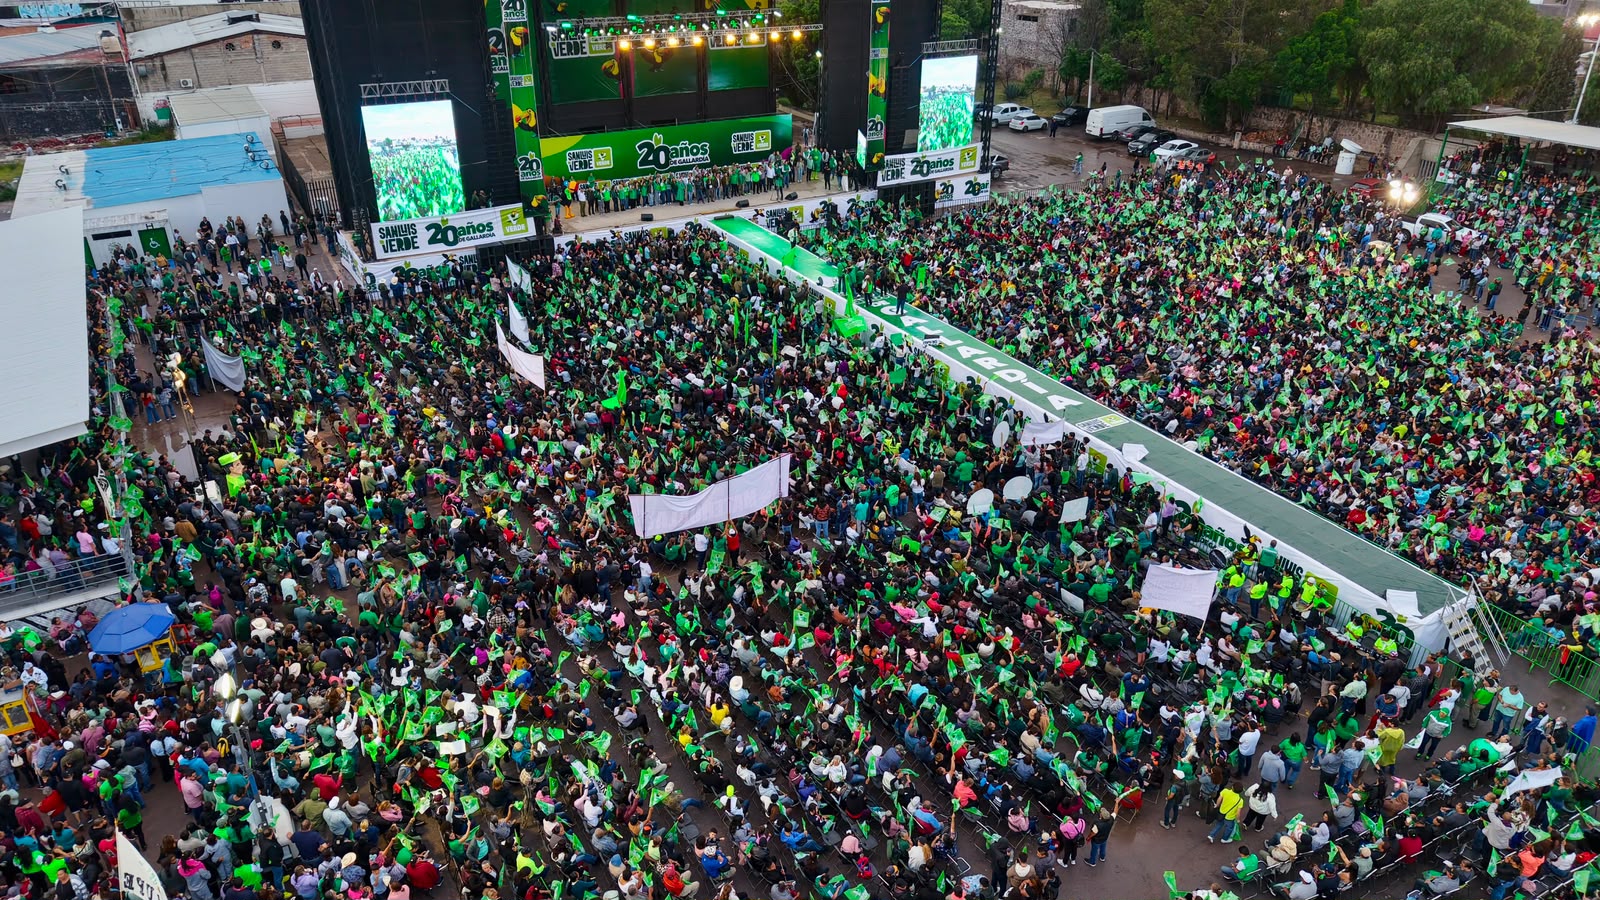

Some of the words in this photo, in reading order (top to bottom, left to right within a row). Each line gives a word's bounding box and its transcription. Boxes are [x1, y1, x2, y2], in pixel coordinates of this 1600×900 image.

[553, 40, 588, 57] VERDE
[868, 120, 884, 132] 20
[733, 141, 755, 152] VERDE
[637, 141, 670, 170] 20
[669, 142, 709, 159] años
[518, 156, 541, 171] 20
[569, 160, 593, 171] VERDE
[910, 157, 930, 177] 20
[929, 157, 955, 169] años
[881, 168, 906, 182] VERDE
[424, 222, 460, 247] 20
[457, 220, 495, 237] años
[505, 223, 526, 233] VERDE
[381, 236, 420, 254] VERDE
